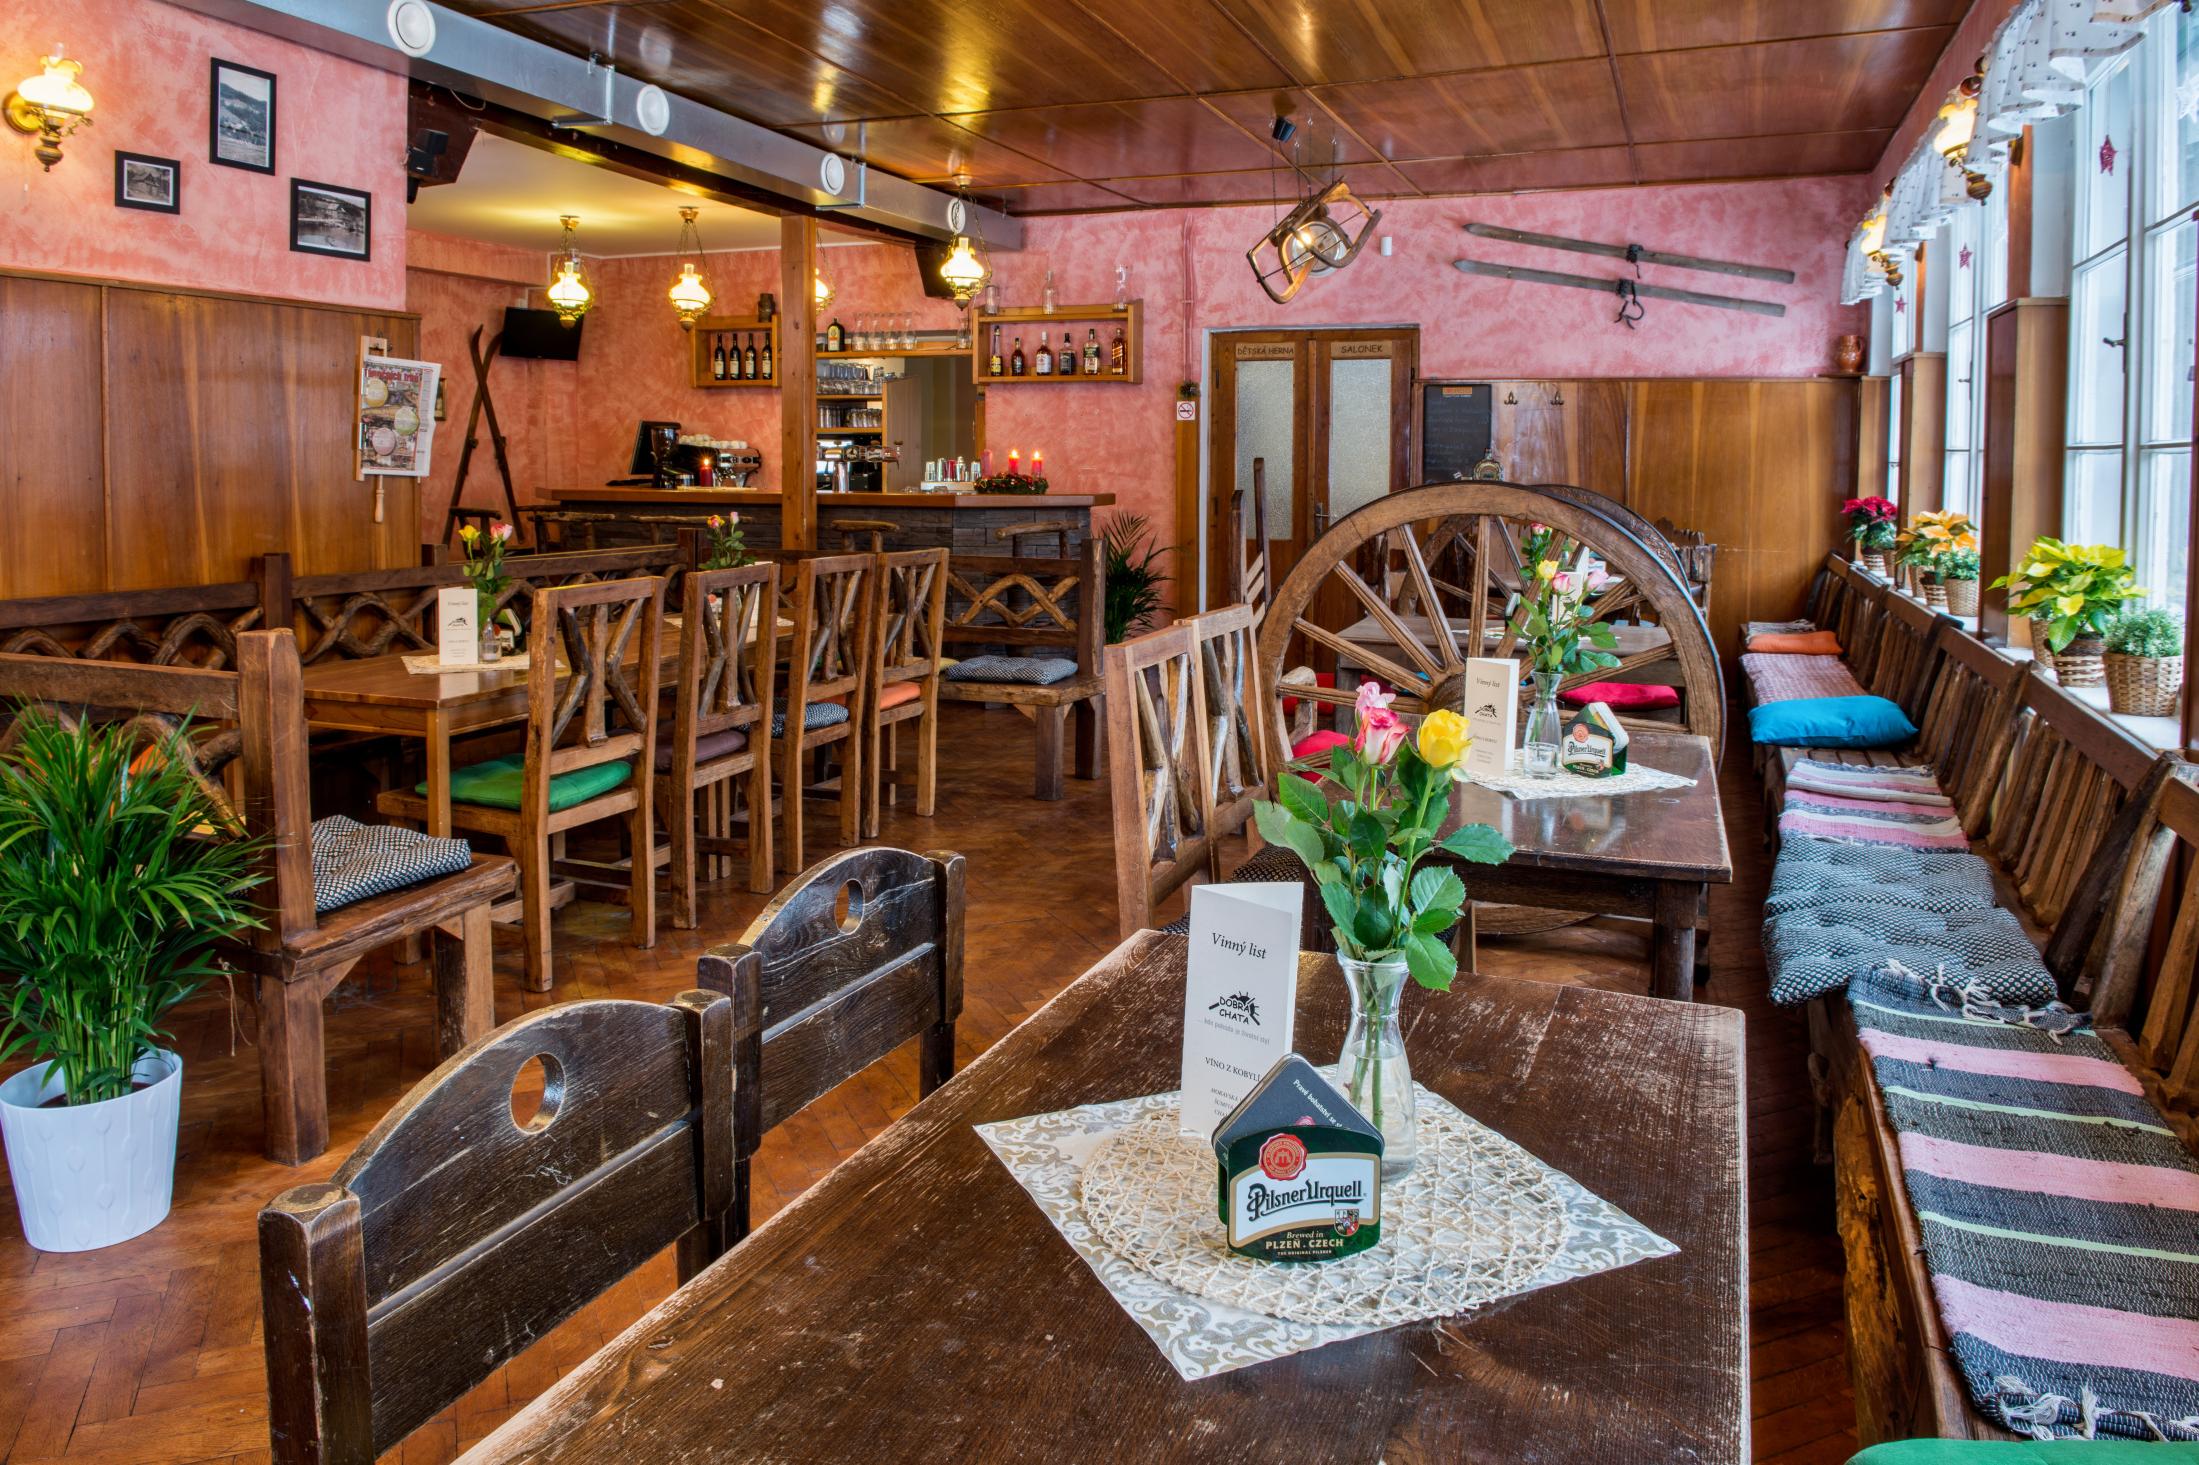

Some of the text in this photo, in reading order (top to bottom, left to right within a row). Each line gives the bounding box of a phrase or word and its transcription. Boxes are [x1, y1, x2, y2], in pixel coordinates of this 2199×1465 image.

[1341, 344, 1383, 354] SALONEK
[1212, 932, 1268, 959] Vinný list
[1219, 1008, 1250, 1025] CHATA
[1205, 1056, 1225, 1071] VÍNO
[1226, 1064, 1232, 1073] Z
[1293, 1079, 1309, 1096] Pravé
[1246, 1178, 1362, 1221] Pilsner Urquell
[1286, 1230, 1324, 1239] Brewed in
[1309, 1238, 1344, 1248] CZECH
